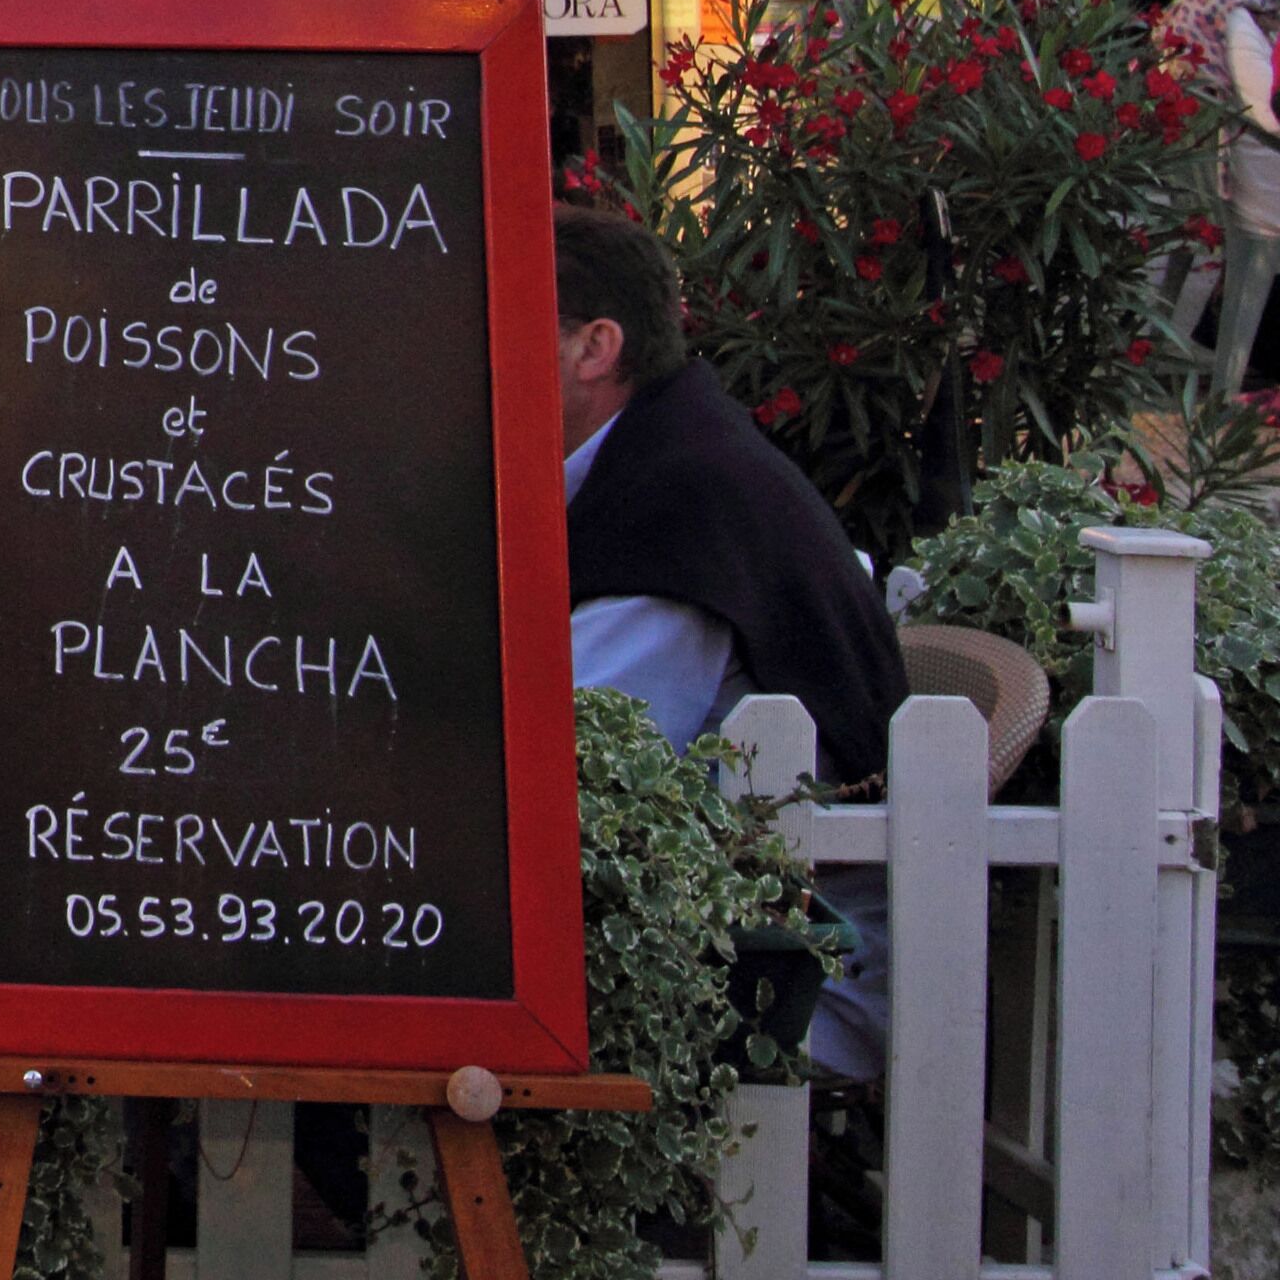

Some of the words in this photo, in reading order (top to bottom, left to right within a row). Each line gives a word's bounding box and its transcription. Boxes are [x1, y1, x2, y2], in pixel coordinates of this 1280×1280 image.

[93, 80, 167, 127] LES
[175, 82, 295, 133] JEUDI
[334, 85, 451, 138] SOIR
[2, 171, 448, 253] PARRILLADA
[168, 267, 218, 304] de
[24, 306, 321, 381] POISSONS
[162, 395, 207, 437] et
[21, 450, 334, 515] CRUSTACÉS
[106, 546, 142, 589] A
[200, 552, 272, 598] LA
[50, 620, 397, 701] PLANCHA
[119, 718, 230, 776] 25€
[25, 791, 416, 871] RÉSERVATION
[65, 893, 443, 949] 05.53.93.20.20
